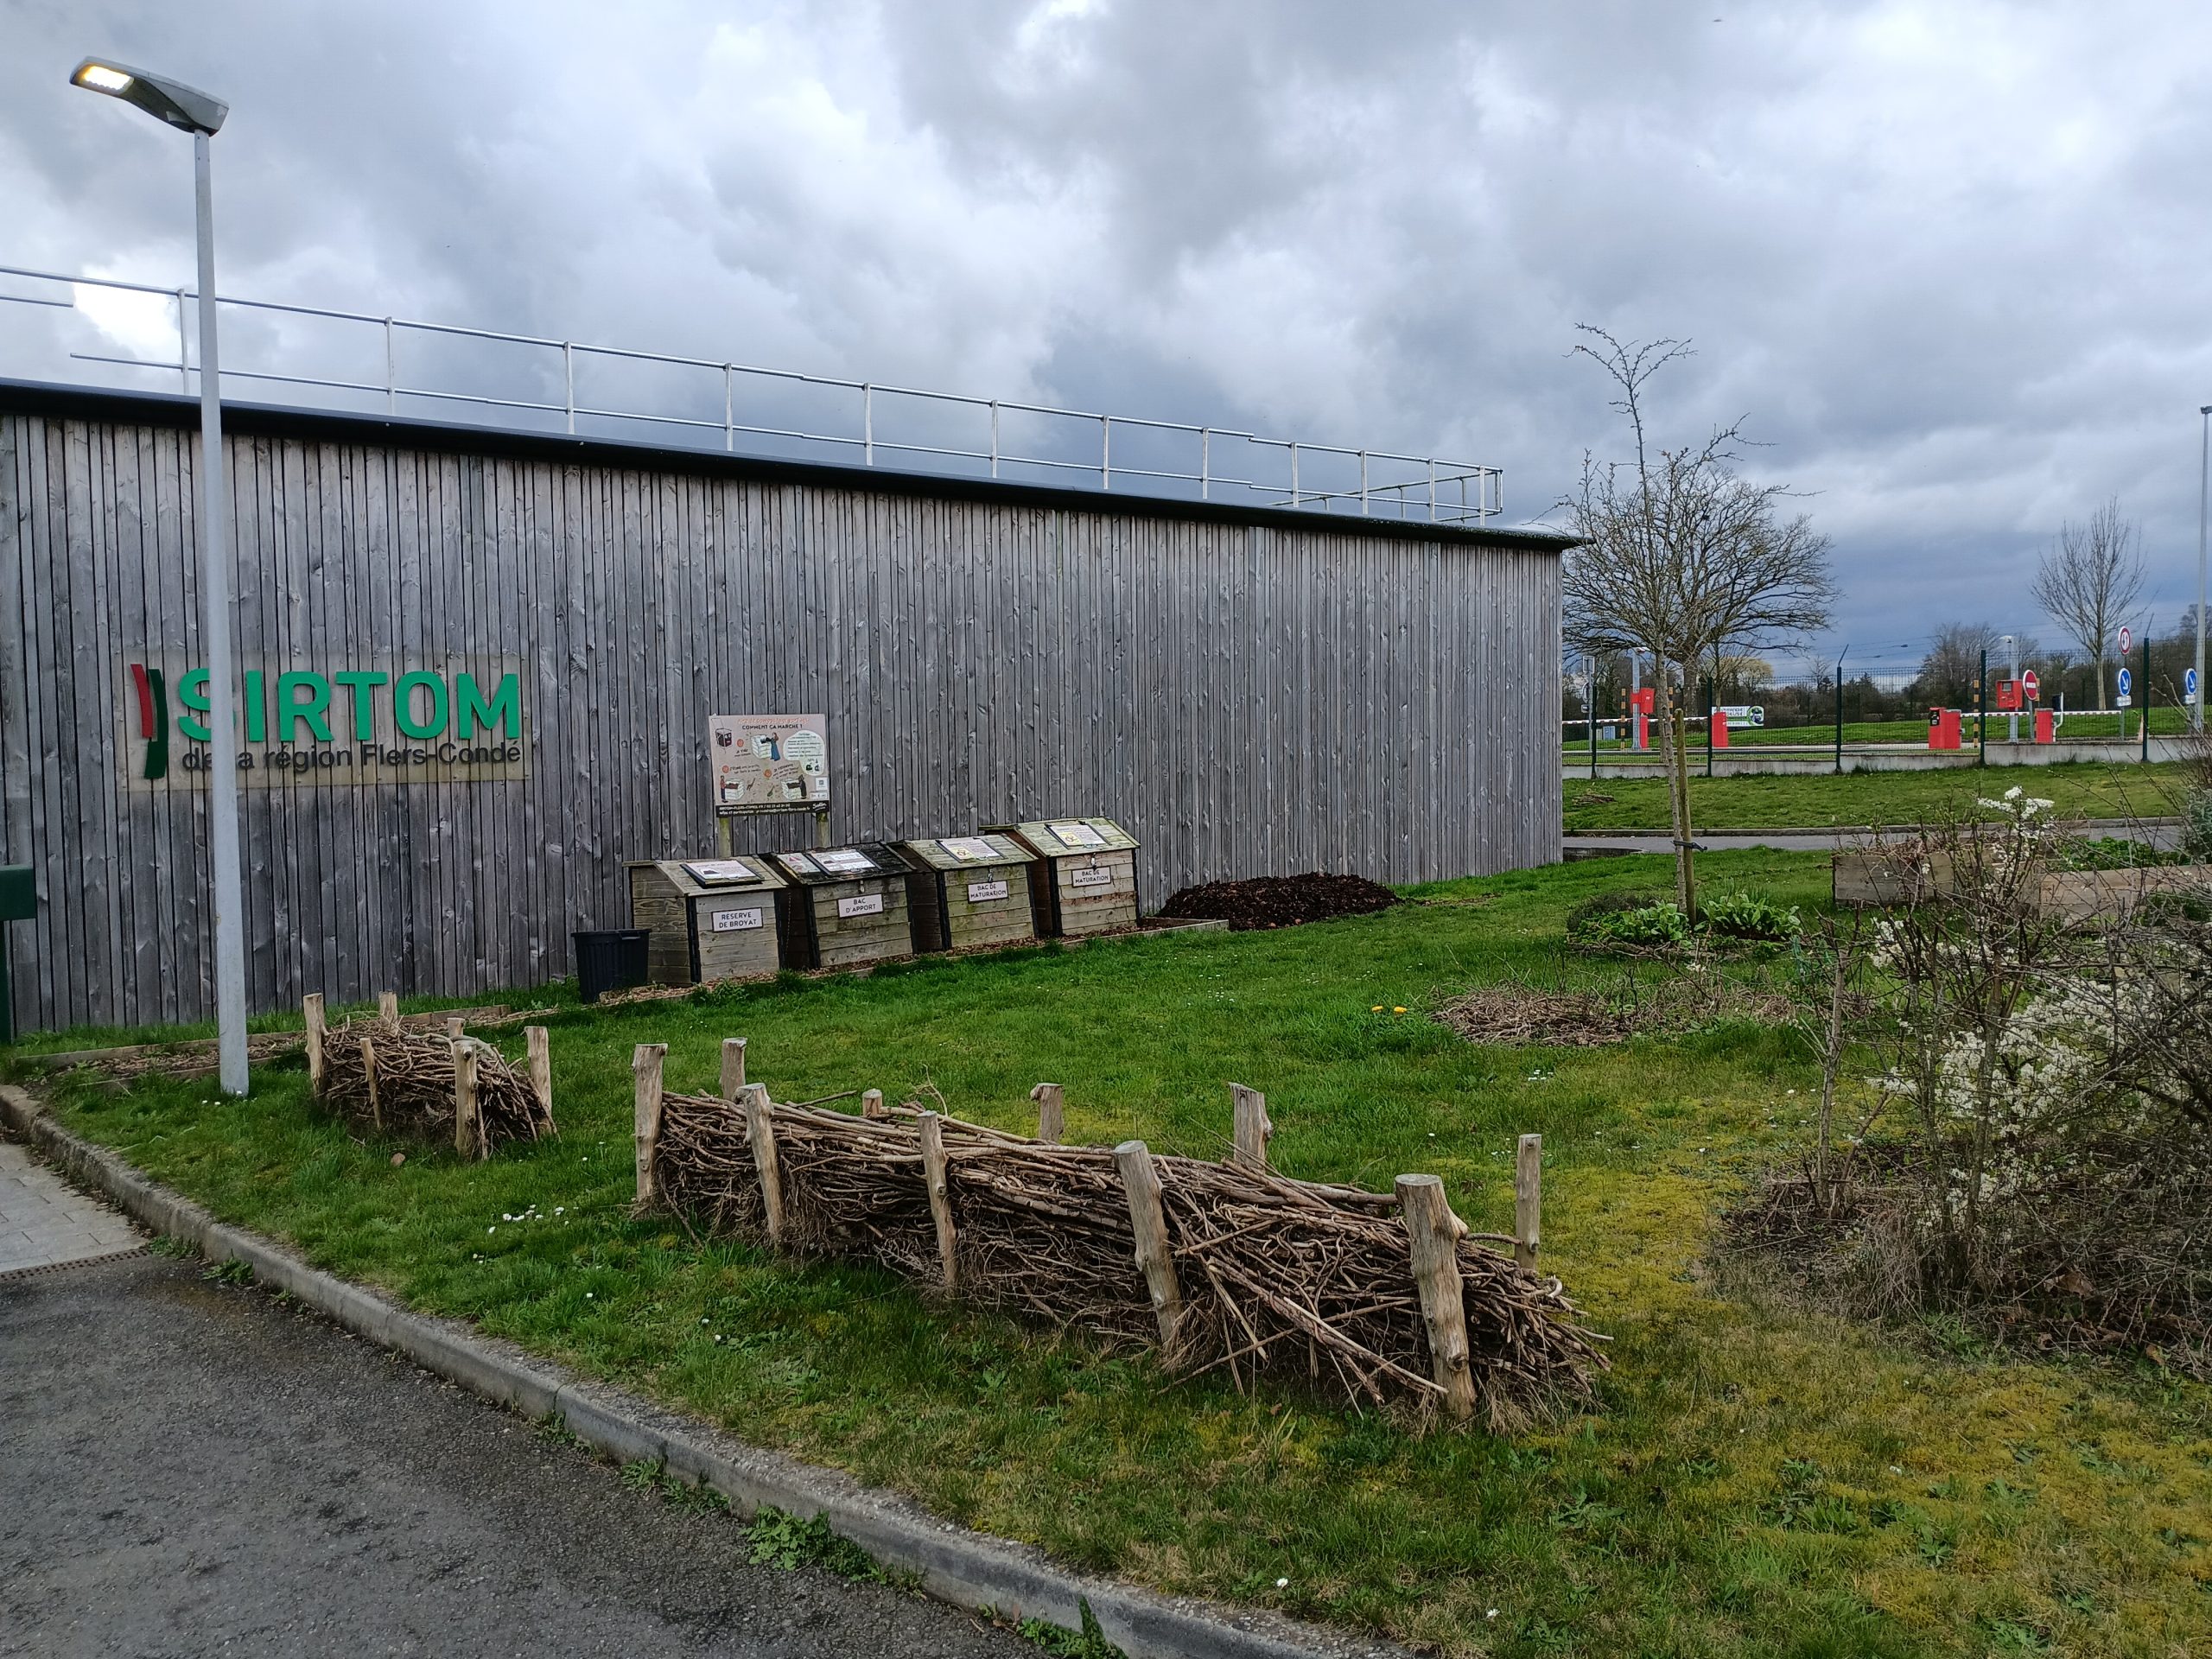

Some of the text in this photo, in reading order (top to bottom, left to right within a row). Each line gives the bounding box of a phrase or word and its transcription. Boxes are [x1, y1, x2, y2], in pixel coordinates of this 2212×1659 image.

[178, 668, 519, 741] SIRTOM
[265, 742, 353, 772] région
[363, 741, 520, 766] Flers-Condé
[721, 912, 752, 920] RÉSERVE
[846, 904, 876, 913] D'APPORT
